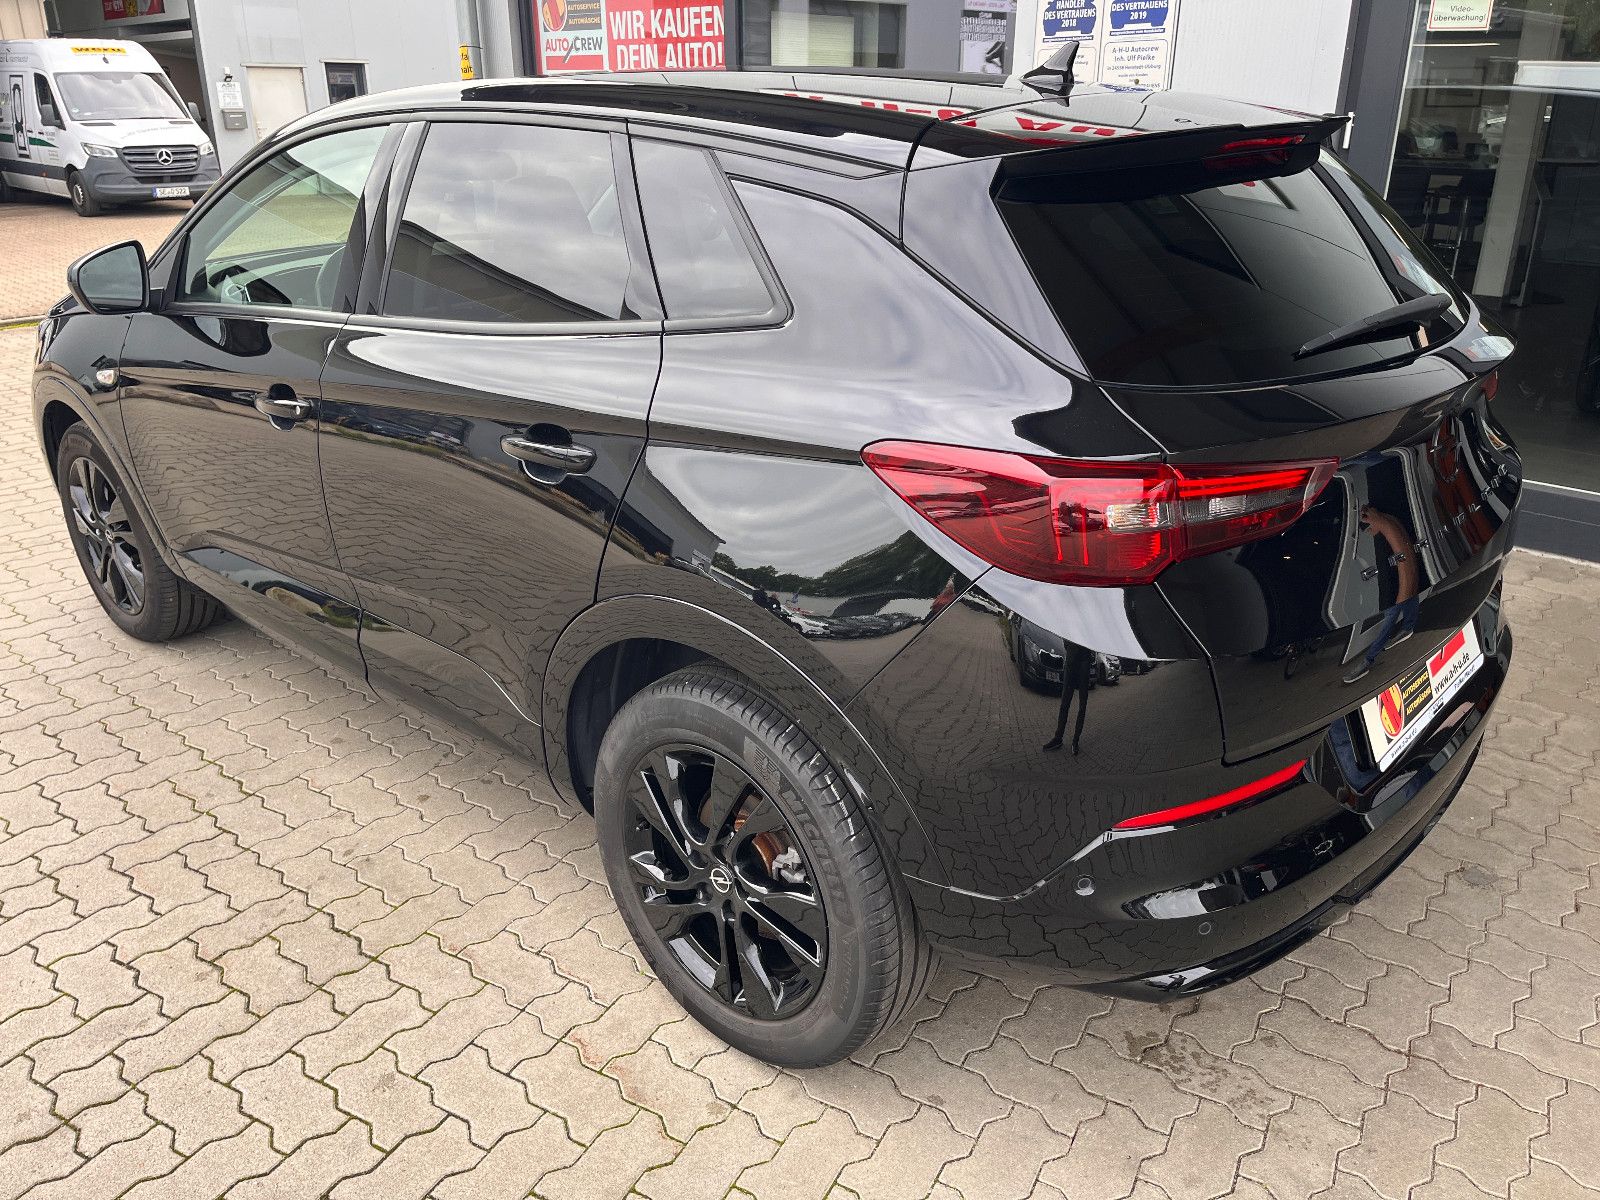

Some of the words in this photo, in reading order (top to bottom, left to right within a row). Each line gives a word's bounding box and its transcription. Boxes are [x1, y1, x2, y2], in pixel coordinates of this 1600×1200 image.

[1125, 1, 1167, 10] VERTRAUENS
[1044, 11, 1056, 20] DES
[1057, 8, 1096, 19] VERTRAUENS
[1130, 11, 1147, 20] 2019
[1433, 14, 1486, 22] überwachung!
[610, 10, 645, 40] WIR
[651, 6, 725, 38] KAUFEN
[1061, 19, 1077, 27] 2018
[546, 38, 569, 52] AUTO
[574, 37, 603, 51] CREW
[617, 43, 658, 70] DEIN
[665, 42, 723, 68] AUTO!
